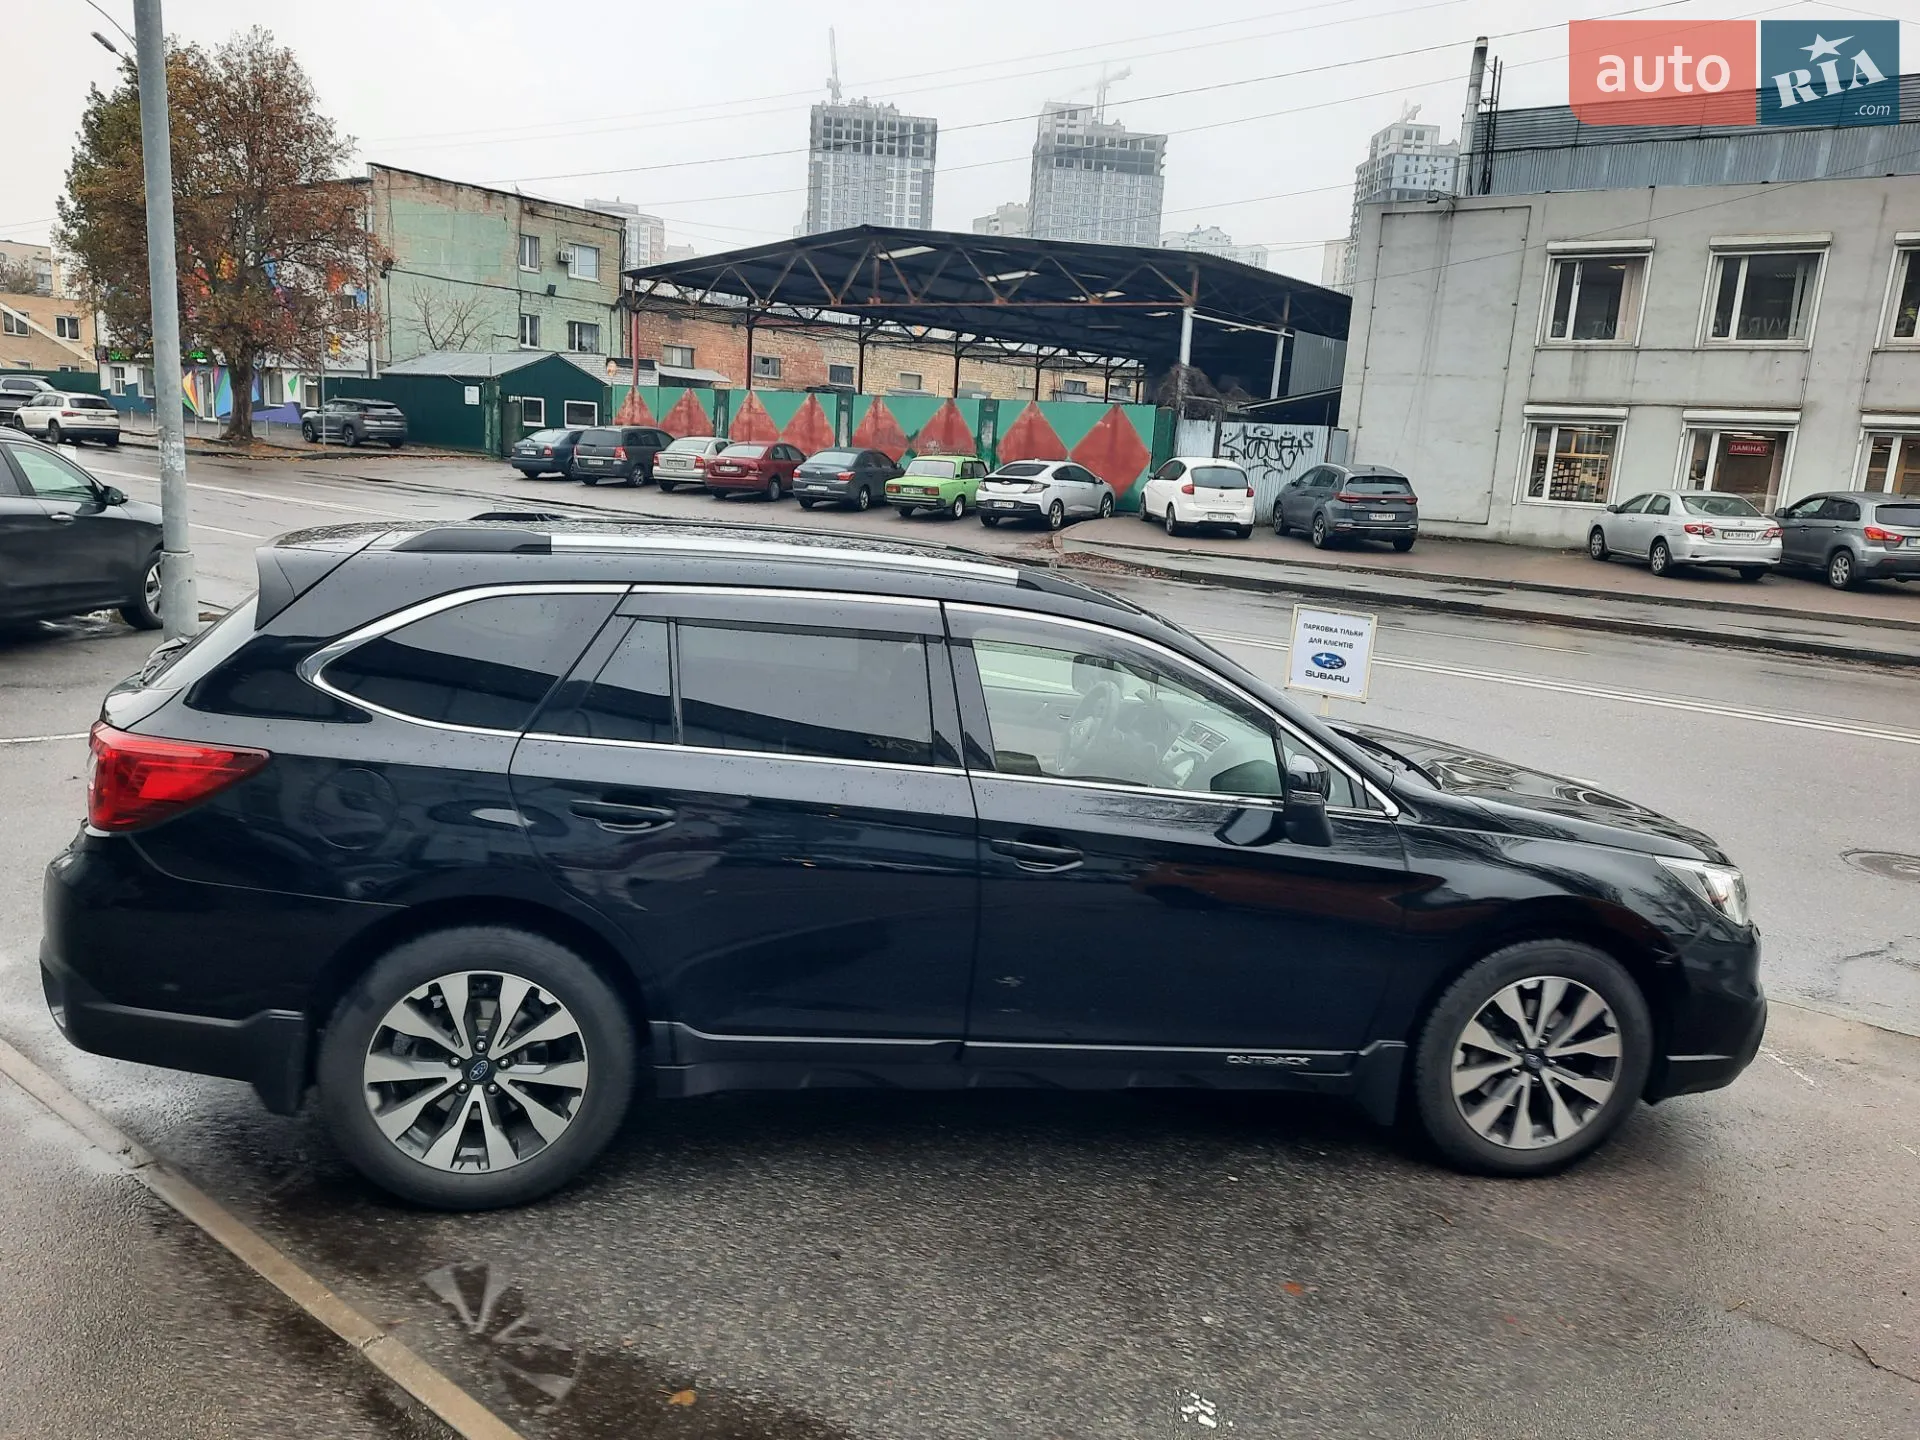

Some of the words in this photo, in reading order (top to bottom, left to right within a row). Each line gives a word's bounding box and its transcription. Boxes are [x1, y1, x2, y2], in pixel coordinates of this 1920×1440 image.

[1303, 622, 1338, 634] ПАРКОВКА
[1340, 627, 1364, 637] ТІЛЬКИ
[1308, 637, 1322, 645] ДЛЯ
[1323, 640, 1354, 649] КЛІЄНТІВ
[1304, 669, 1350, 683] SUBARU
